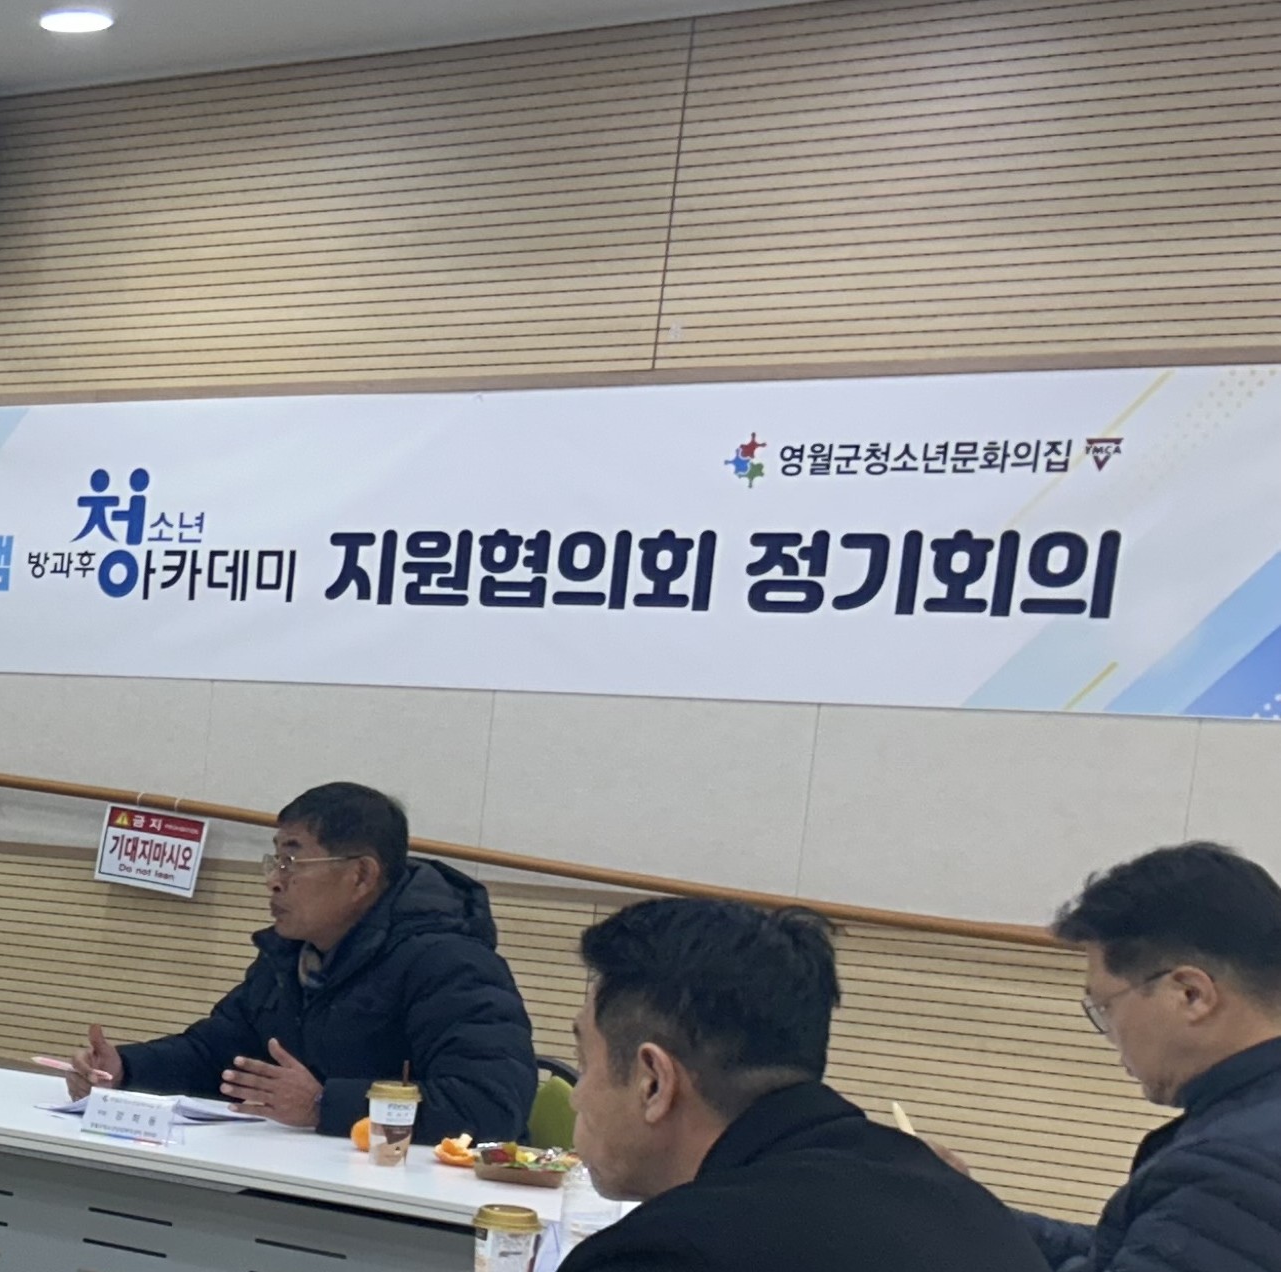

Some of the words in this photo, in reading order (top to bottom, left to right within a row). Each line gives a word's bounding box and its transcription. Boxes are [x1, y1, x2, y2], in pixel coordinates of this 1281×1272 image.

[779, 439, 1073, 476] 영월군청소년문화의집
[28, 551, 96, 578] 방과후
[97, 549, 297, 603] 아카데미
[324, 528, 717, 611] 지원협의회
[745, 529, 1122, 619] 정기회의
[109, 835, 193, 871] 기대지마시오
[119, 863, 133, 873] Do
[135, 868, 152, 876] not
